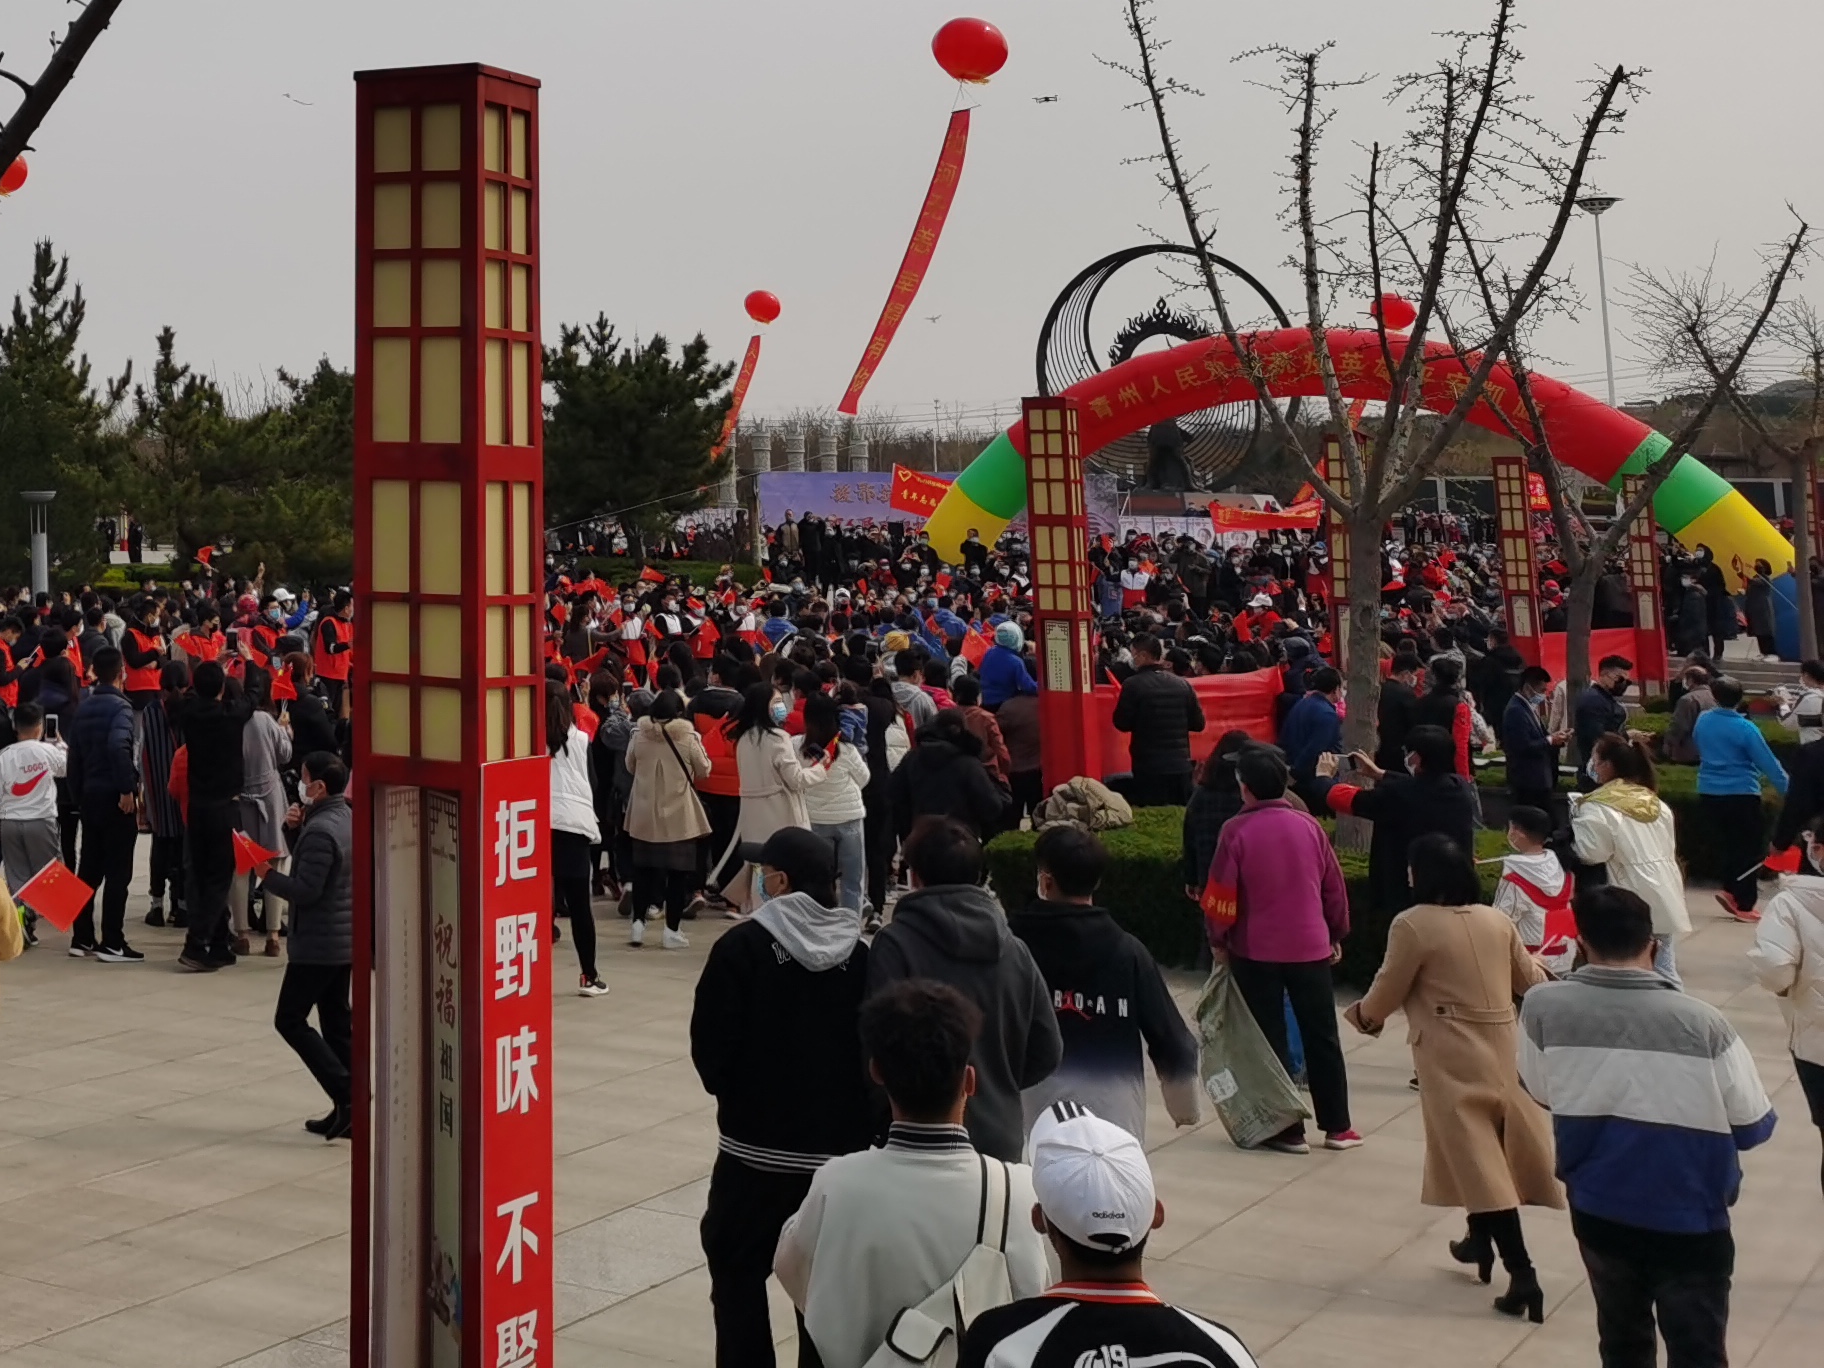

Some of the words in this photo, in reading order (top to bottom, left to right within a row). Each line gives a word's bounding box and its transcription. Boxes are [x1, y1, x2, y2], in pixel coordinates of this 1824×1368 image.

[433, 913, 458, 1139] 祝福祖国
[494, 798, 539, 1115] 拒野味
